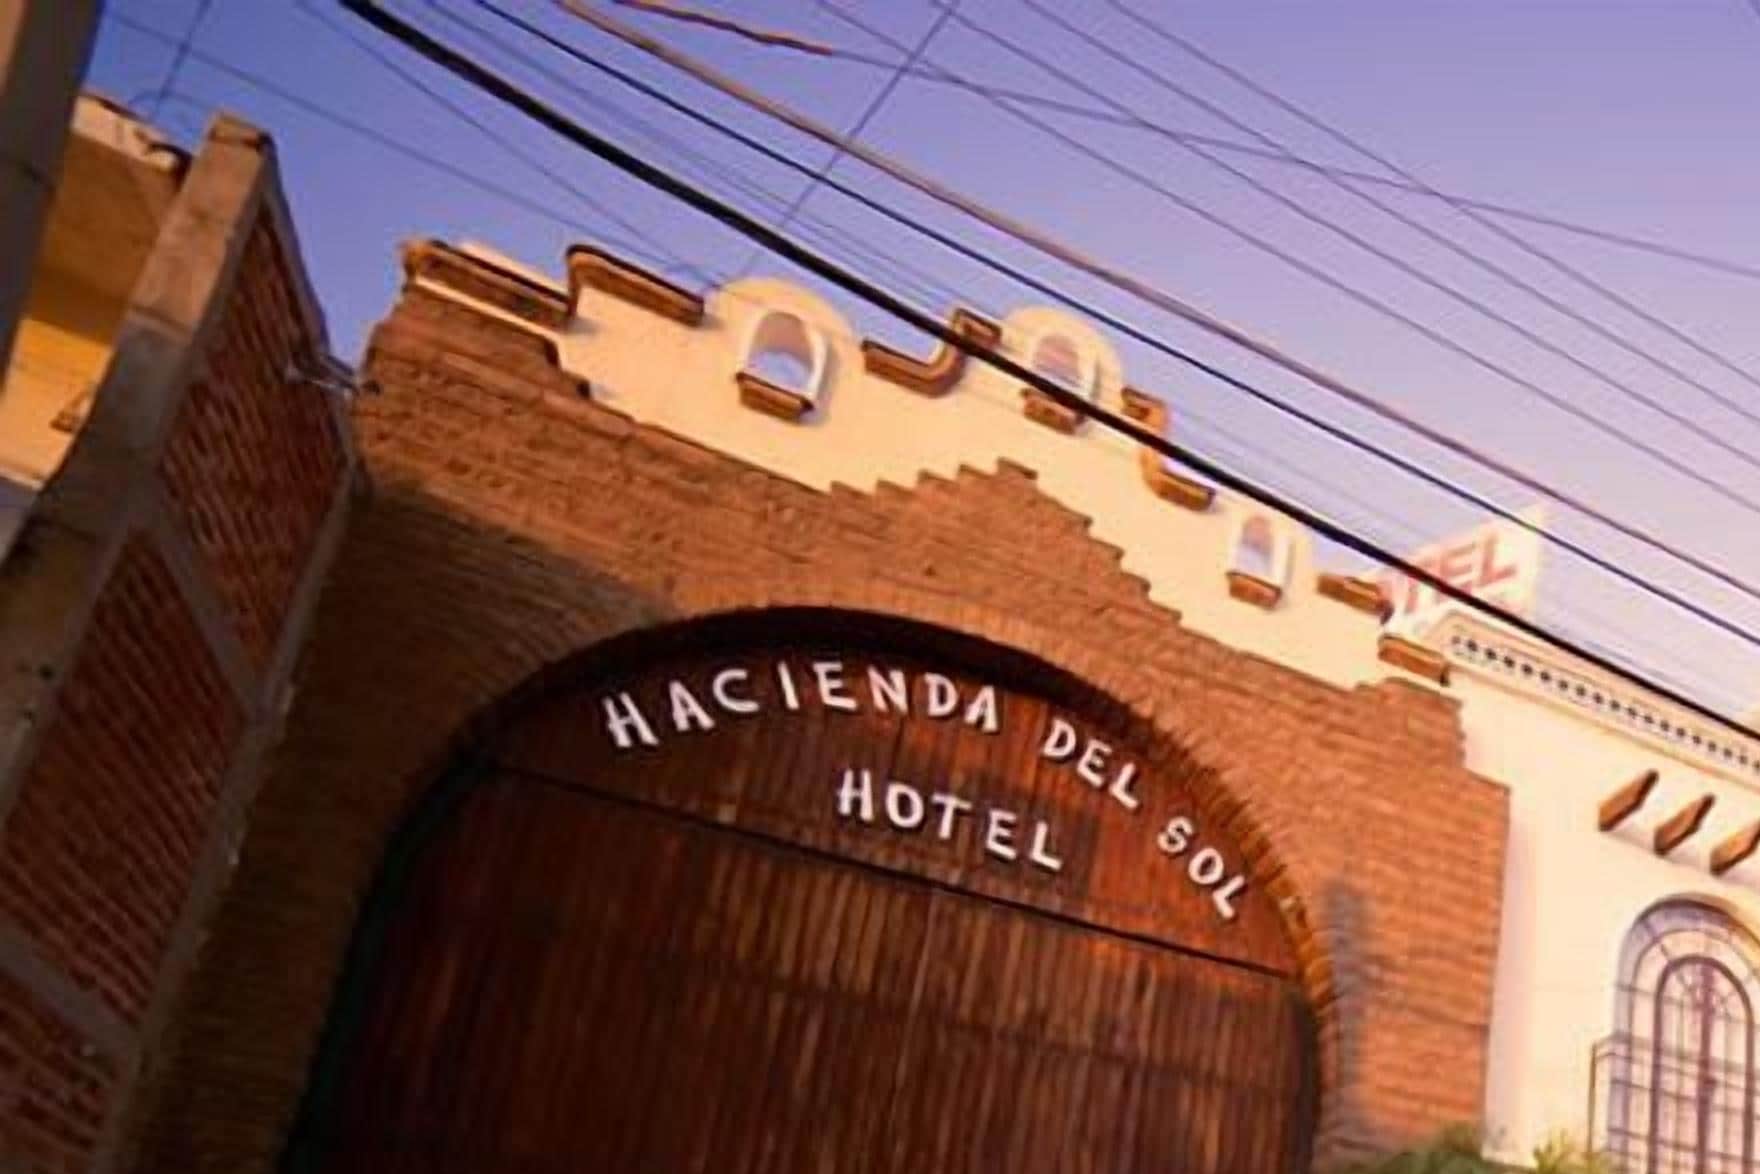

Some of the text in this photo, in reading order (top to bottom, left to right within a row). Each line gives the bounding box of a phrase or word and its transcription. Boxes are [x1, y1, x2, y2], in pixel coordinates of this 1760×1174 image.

[1382, 534, 1518, 614] TEL
[603, 660, 1248, 919] HACIENDA DEL SOL
[836, 768, 1063, 871] HOTEL
